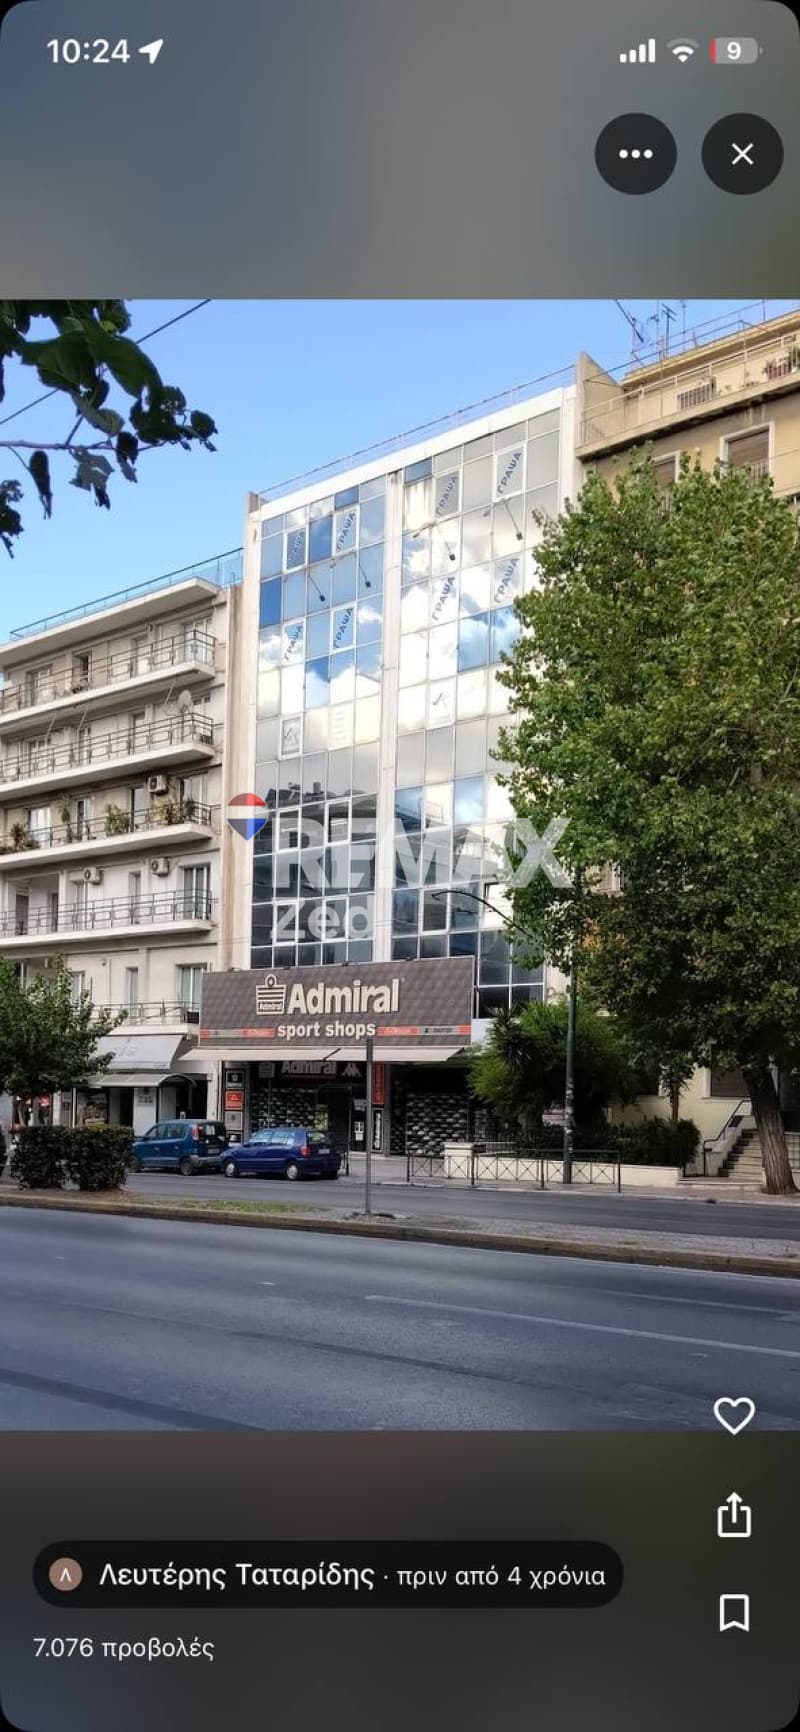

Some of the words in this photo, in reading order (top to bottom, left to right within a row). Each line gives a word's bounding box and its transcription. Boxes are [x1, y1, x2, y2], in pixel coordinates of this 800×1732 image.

[287, 978, 399, 1015] Admiral
[277, 1022, 320, 1040] sport
[325, 1020, 376, 1040] shops
